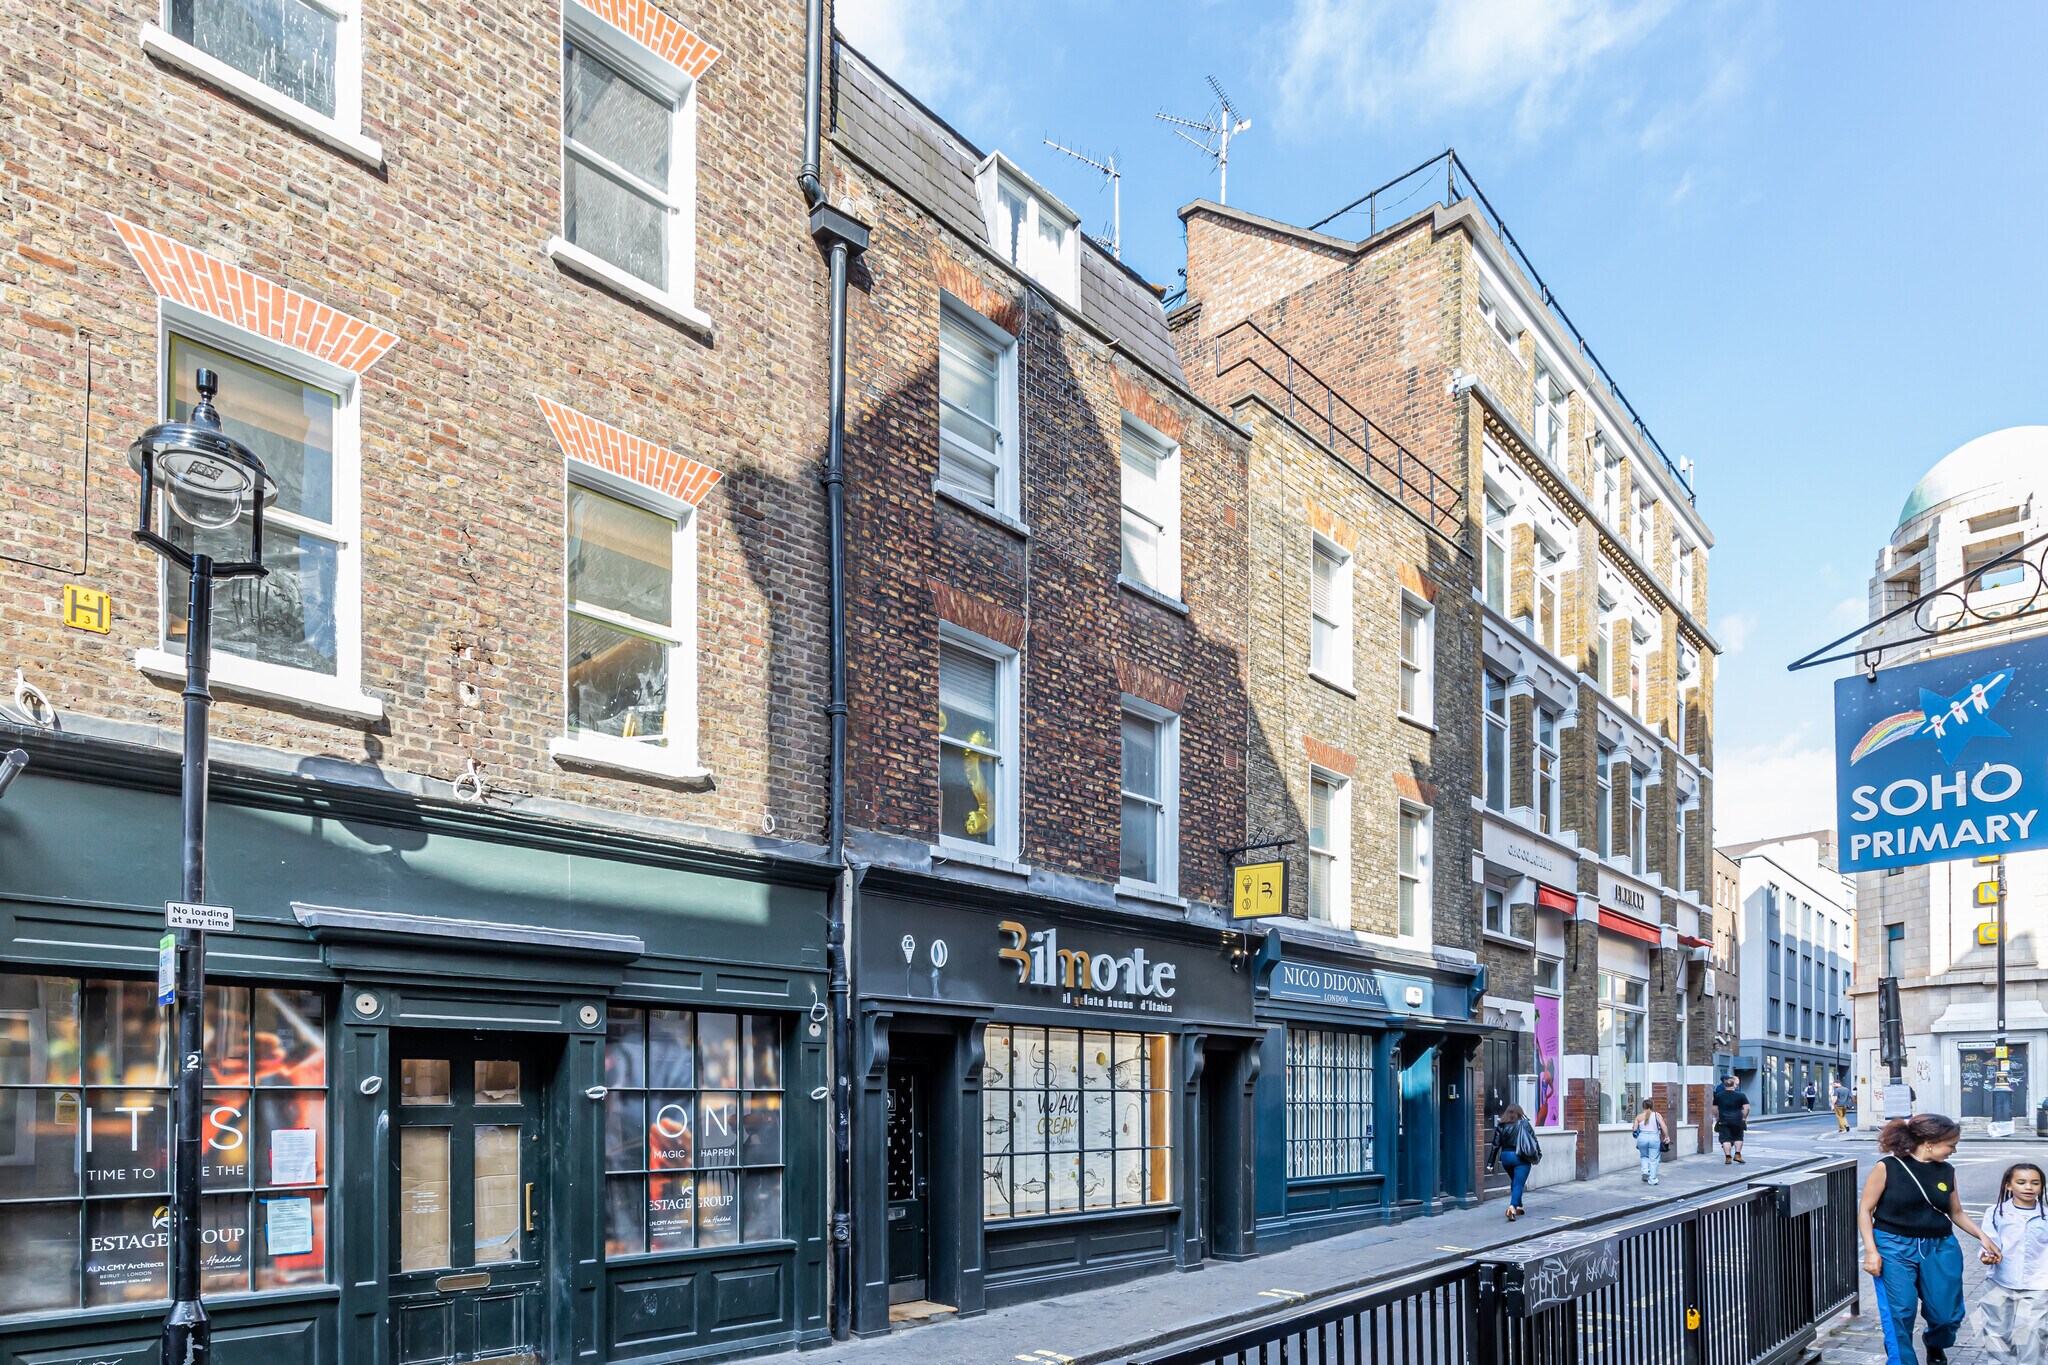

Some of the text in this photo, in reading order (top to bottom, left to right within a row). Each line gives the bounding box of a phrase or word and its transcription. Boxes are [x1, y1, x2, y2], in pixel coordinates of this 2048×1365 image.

[84, 594, 90, 602] 4
[71, 589, 103, 628] H
[84, 615, 91, 624] 3
[1850, 764, 2023, 822] SOHO
[1851, 809, 2039, 861] PRIMARY
[173, 906, 229, 919] No loading
[172, 916, 230, 927] at any time
[1284, 966, 1383, 997] NICO DIDONNA
[1062, 993, 1071, 1004] il
[1324, 993, 1349, 1003] LONDON
[186, 1054, 199, 1069] 2
[653, 1148, 735, 1159] MAGIC HAPPEN
[87, 1169, 126, 1181] TIME
[132, 1168, 156, 1179] TO
[216, 1165, 244, 1176] THE
[90, 1228, 245, 1252] ESTAGE OUP
[86, 1261, 165, 1273] ALN.CMY Architects
